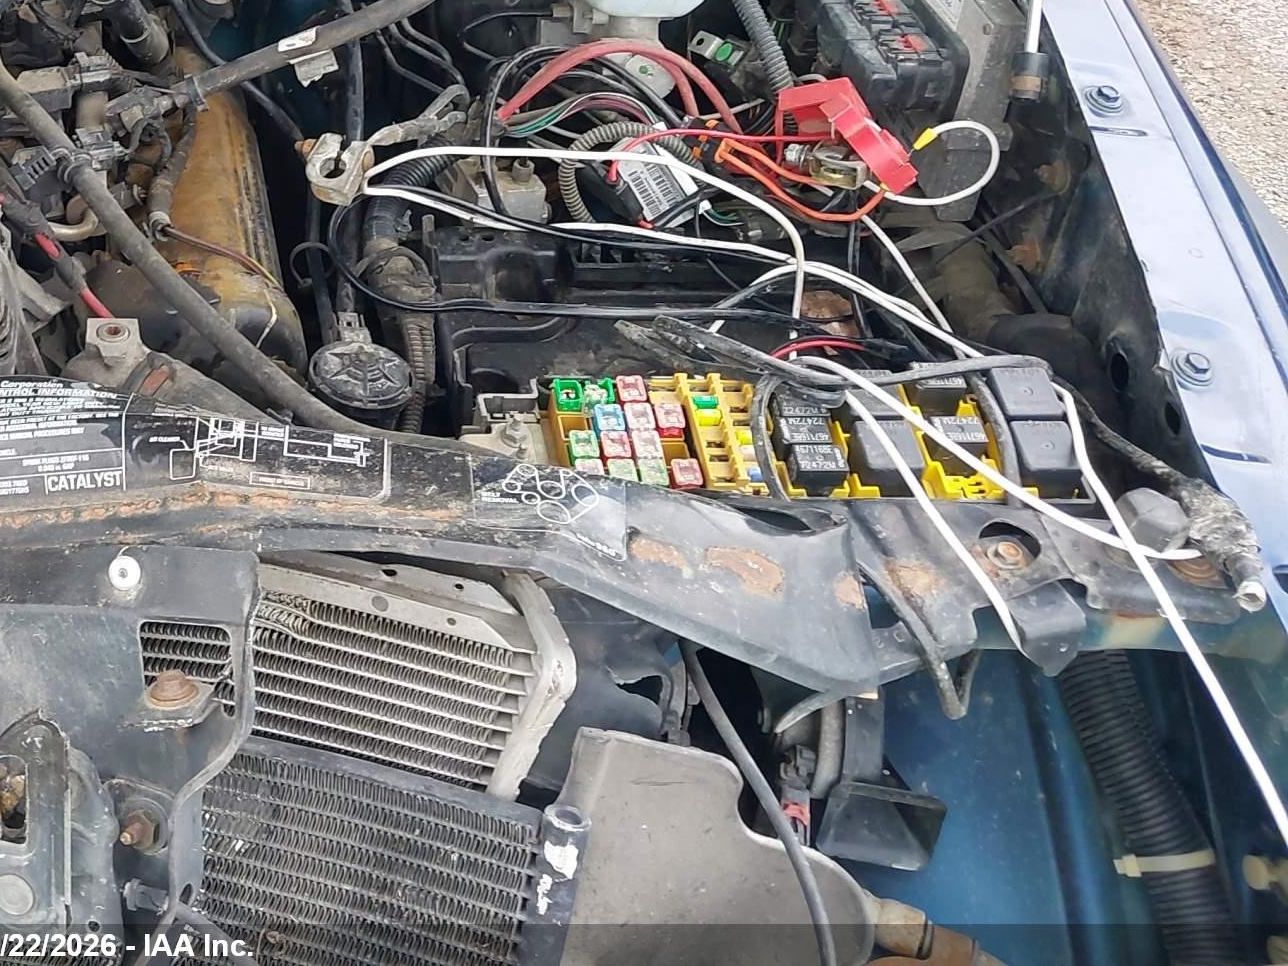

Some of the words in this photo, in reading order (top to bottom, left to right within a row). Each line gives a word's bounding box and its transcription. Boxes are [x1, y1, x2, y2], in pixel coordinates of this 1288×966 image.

[0, 380, 64, 389] Corporation
[37, 388, 118, 399] INFORMATION
[47, 470, 122, 492] CATALYST
